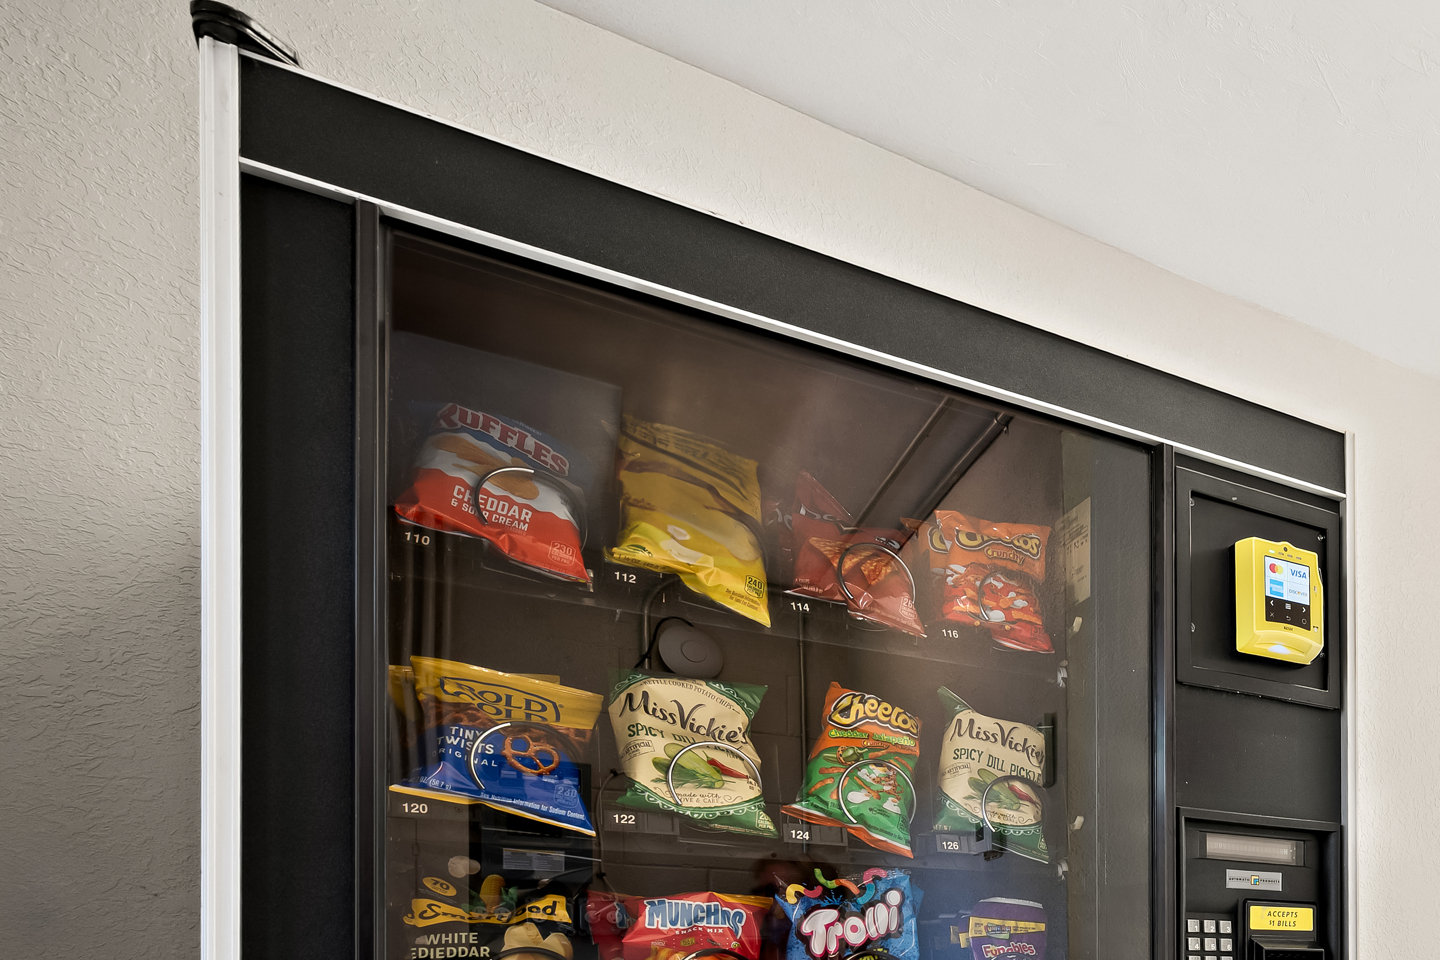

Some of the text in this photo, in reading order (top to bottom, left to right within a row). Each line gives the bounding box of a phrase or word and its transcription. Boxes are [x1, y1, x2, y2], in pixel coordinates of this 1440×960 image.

[437, 402, 569, 477] RUFFLES
[451, 498, 458, 507] &
[461, 502, 489, 521] SOR
[492, 514, 529, 532] CREAM
[404, 531, 430, 546] 110
[984, 546, 1027, 566] Crunchy
[614, 571, 637, 584] 112
[1290, 568, 1307, 579] VISA
[790, 601, 810, 613] 114
[941, 628, 959, 639] 116
[715, 697, 734, 710] CHIPS
[619, 690, 749, 745] Miss Vickie's
[829, 692, 919, 737] Cheetos
[450, 726, 484, 740] TINY
[627, 722, 665, 739] SPICY
[437, 736, 494, 755] TWISTS
[950, 718, 1044, 768] Miss Vickie
[953, 748, 984, 763] SPICY
[986, 754, 1005, 773] DILL
[402, 803, 428, 814] 120
[613, 814, 636, 825] 122
[790, 829, 810, 841] 124
[942, 841, 959, 850] 126
[1267, 910, 1299, 918] ACCEPTS
[801, 889, 901, 958] Trolli
[1277, 920, 1297, 928] BILLS
[675, 927, 703, 935] SNACK
[425, 932, 479, 946] WHITE
[982, 942, 1036, 958] Funables
